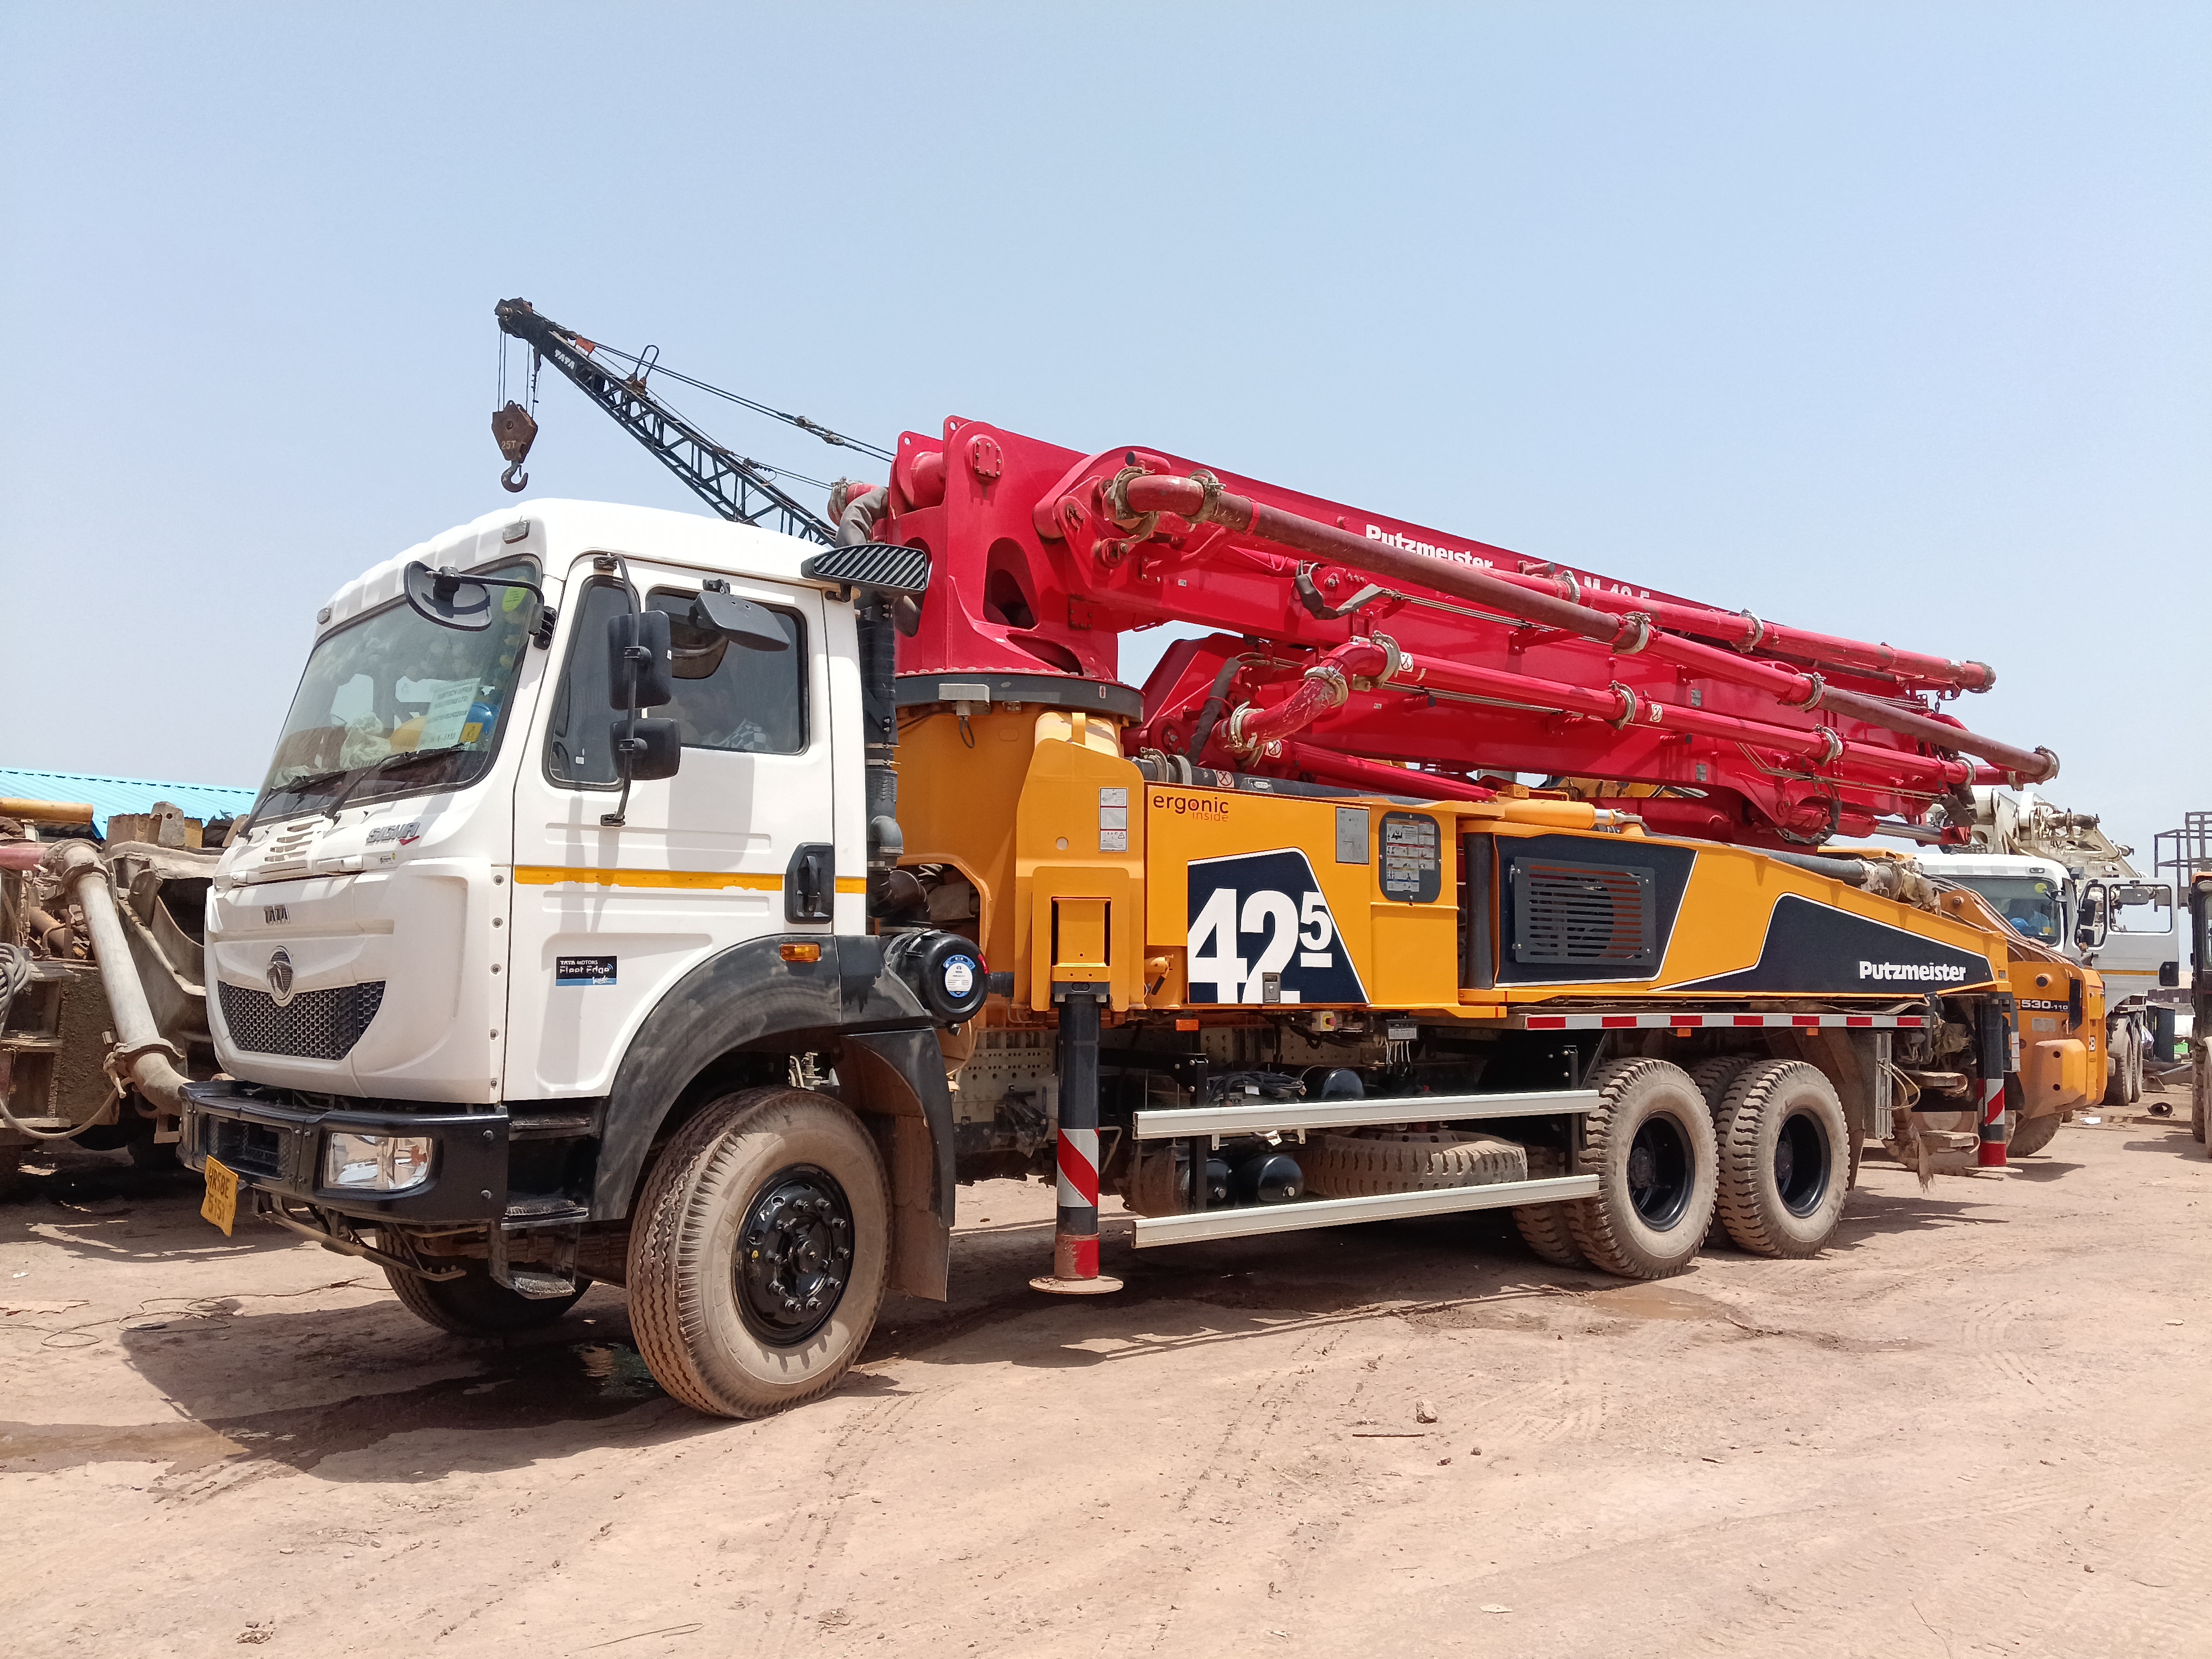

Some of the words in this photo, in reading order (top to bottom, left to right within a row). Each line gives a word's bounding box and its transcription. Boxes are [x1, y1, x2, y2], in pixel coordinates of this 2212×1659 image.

[554, 349, 575, 370] TATA
[501, 440, 517, 450] 25T
[1365, 523, 1494, 569] Putzmeister
[1153, 795, 1229, 814] ergonic
[1192, 811, 1229, 822] inside
[365, 822, 421, 844] SIGNA
[263, 903, 291, 925] TATA
[559, 966, 584, 974] Fleet
[586, 965, 610, 974] Edge
[1859, 961, 1966, 981] Putzmeister
[207, 1164, 231, 1200] HR58E
